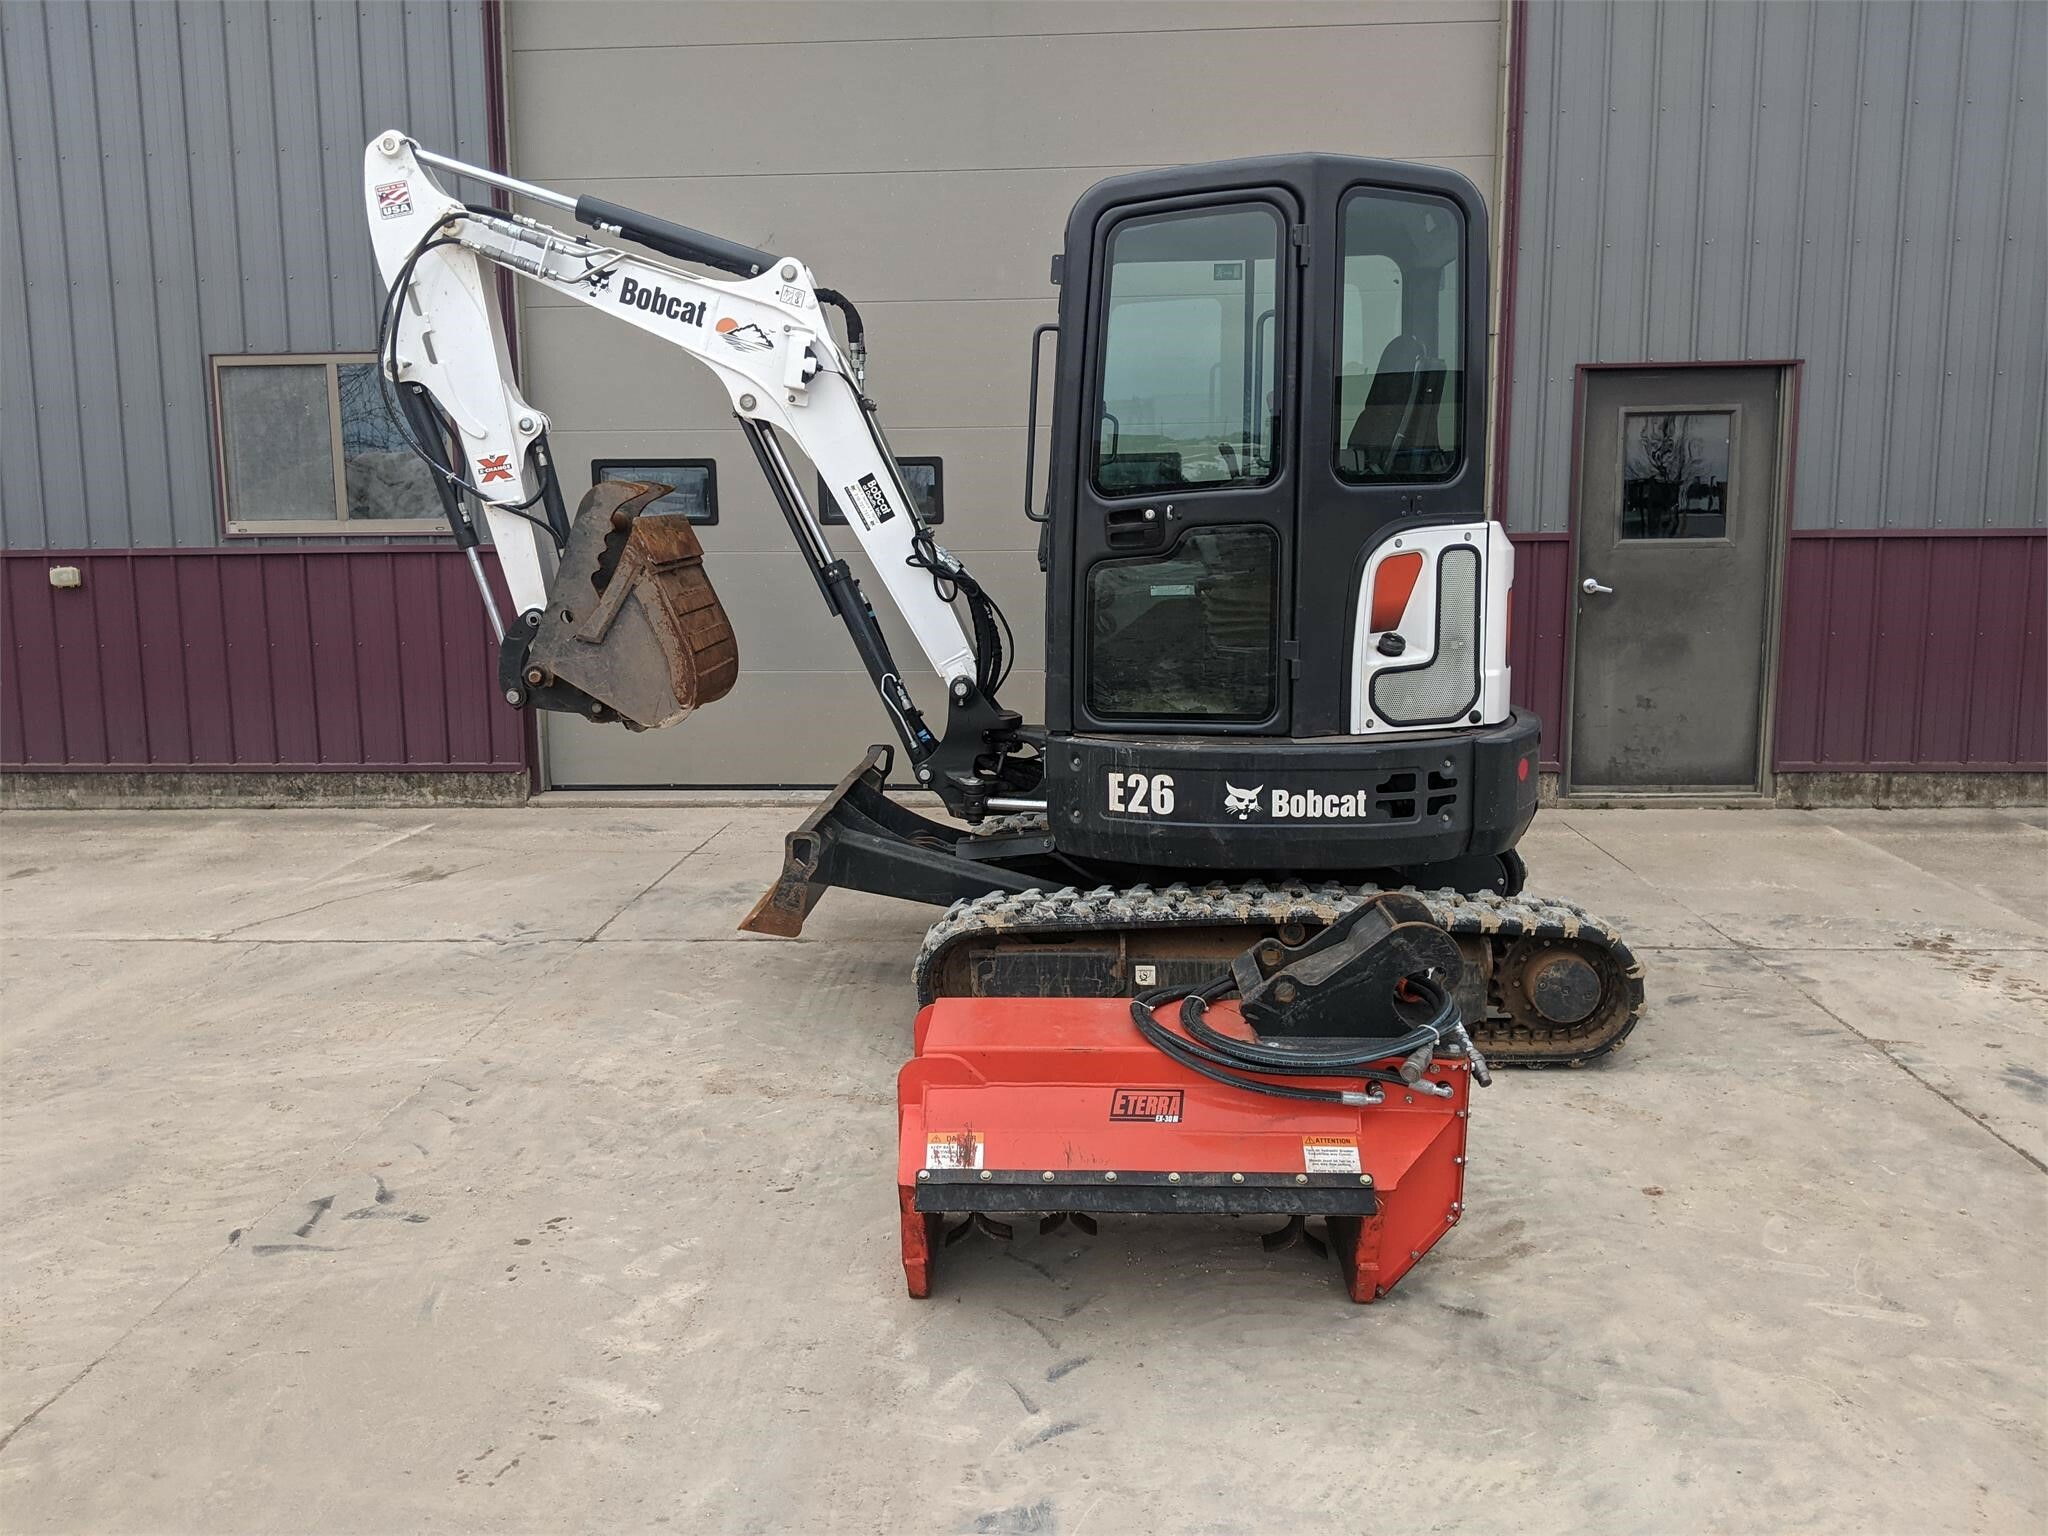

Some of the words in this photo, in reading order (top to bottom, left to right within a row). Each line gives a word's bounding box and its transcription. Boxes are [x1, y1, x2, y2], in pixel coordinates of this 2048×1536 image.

[382, 203, 410, 216] USA
[619, 277, 707, 328] Bobcat
[867, 479, 892, 515] Bobcat
[1108, 773, 1175, 815] E26
[1271, 789, 1367, 818] Bobcat
[1112, 1091, 1181, 1115] ETERRA
[1315, 1137, 1351, 1145] ATTENTION
